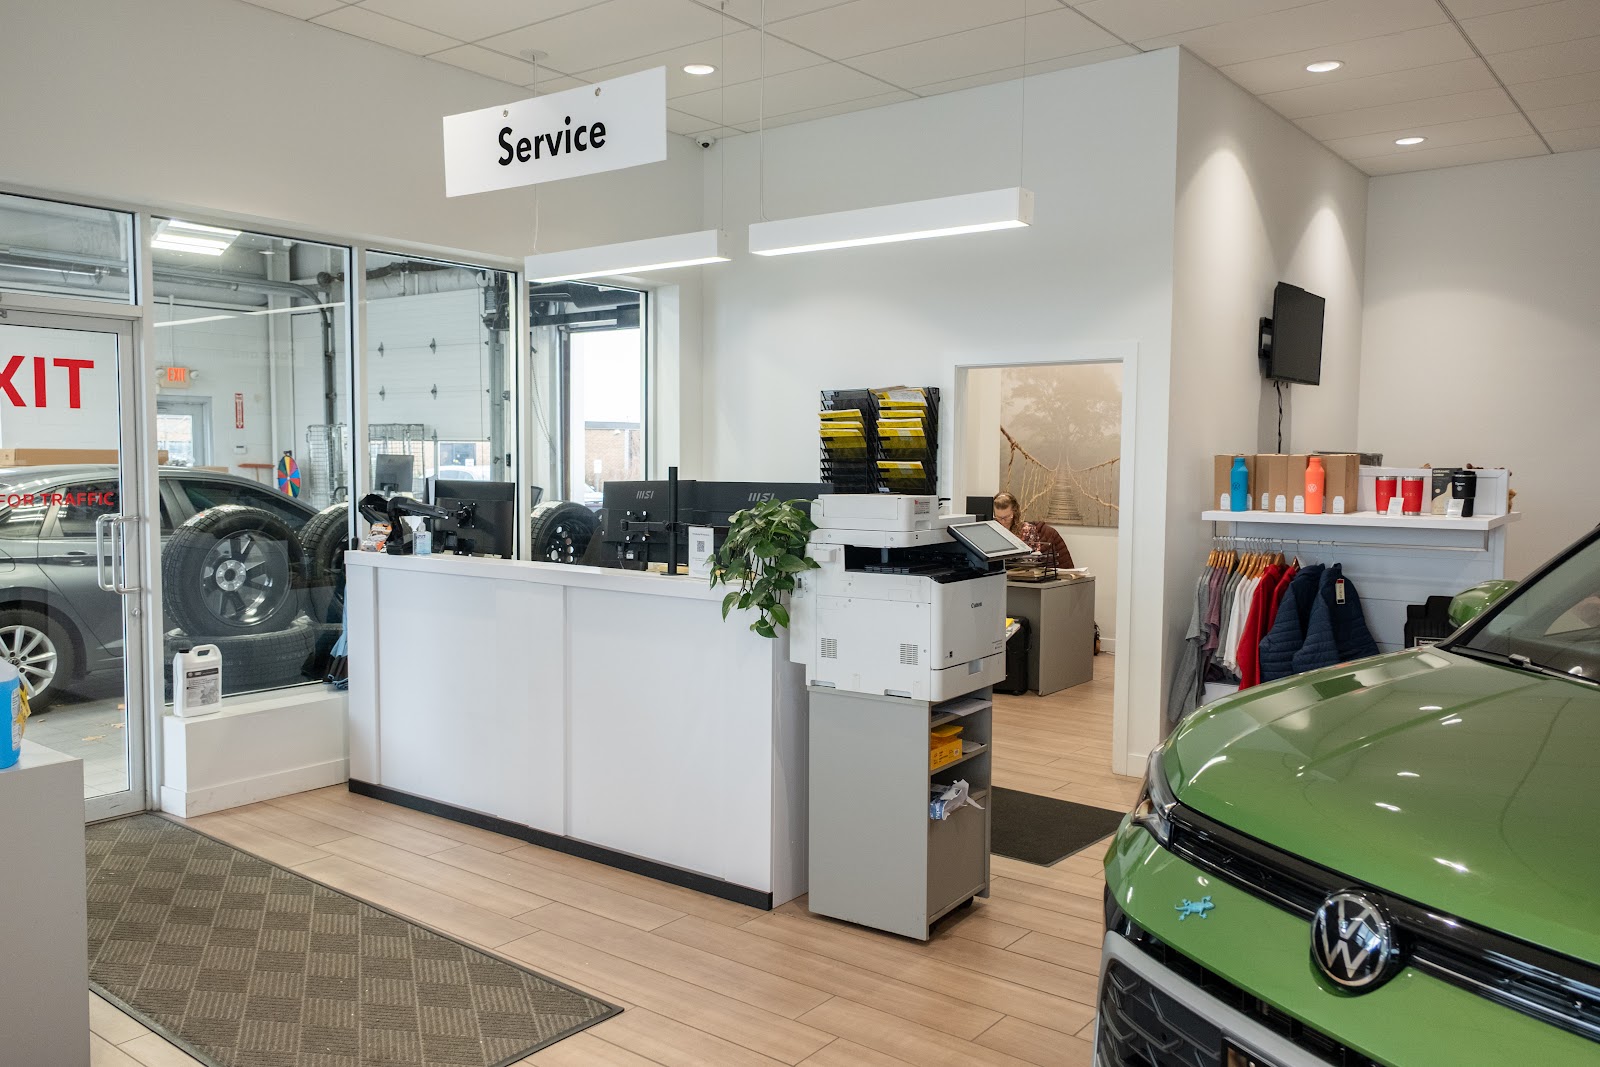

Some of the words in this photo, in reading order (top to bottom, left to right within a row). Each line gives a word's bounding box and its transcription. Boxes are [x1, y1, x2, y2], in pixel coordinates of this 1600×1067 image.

[498, 115, 606, 166] Service
[167, 367, 186, 382] EXIT
[39, 491, 114, 507] TRAFFIC
[636, 490, 655, 500] MSI
